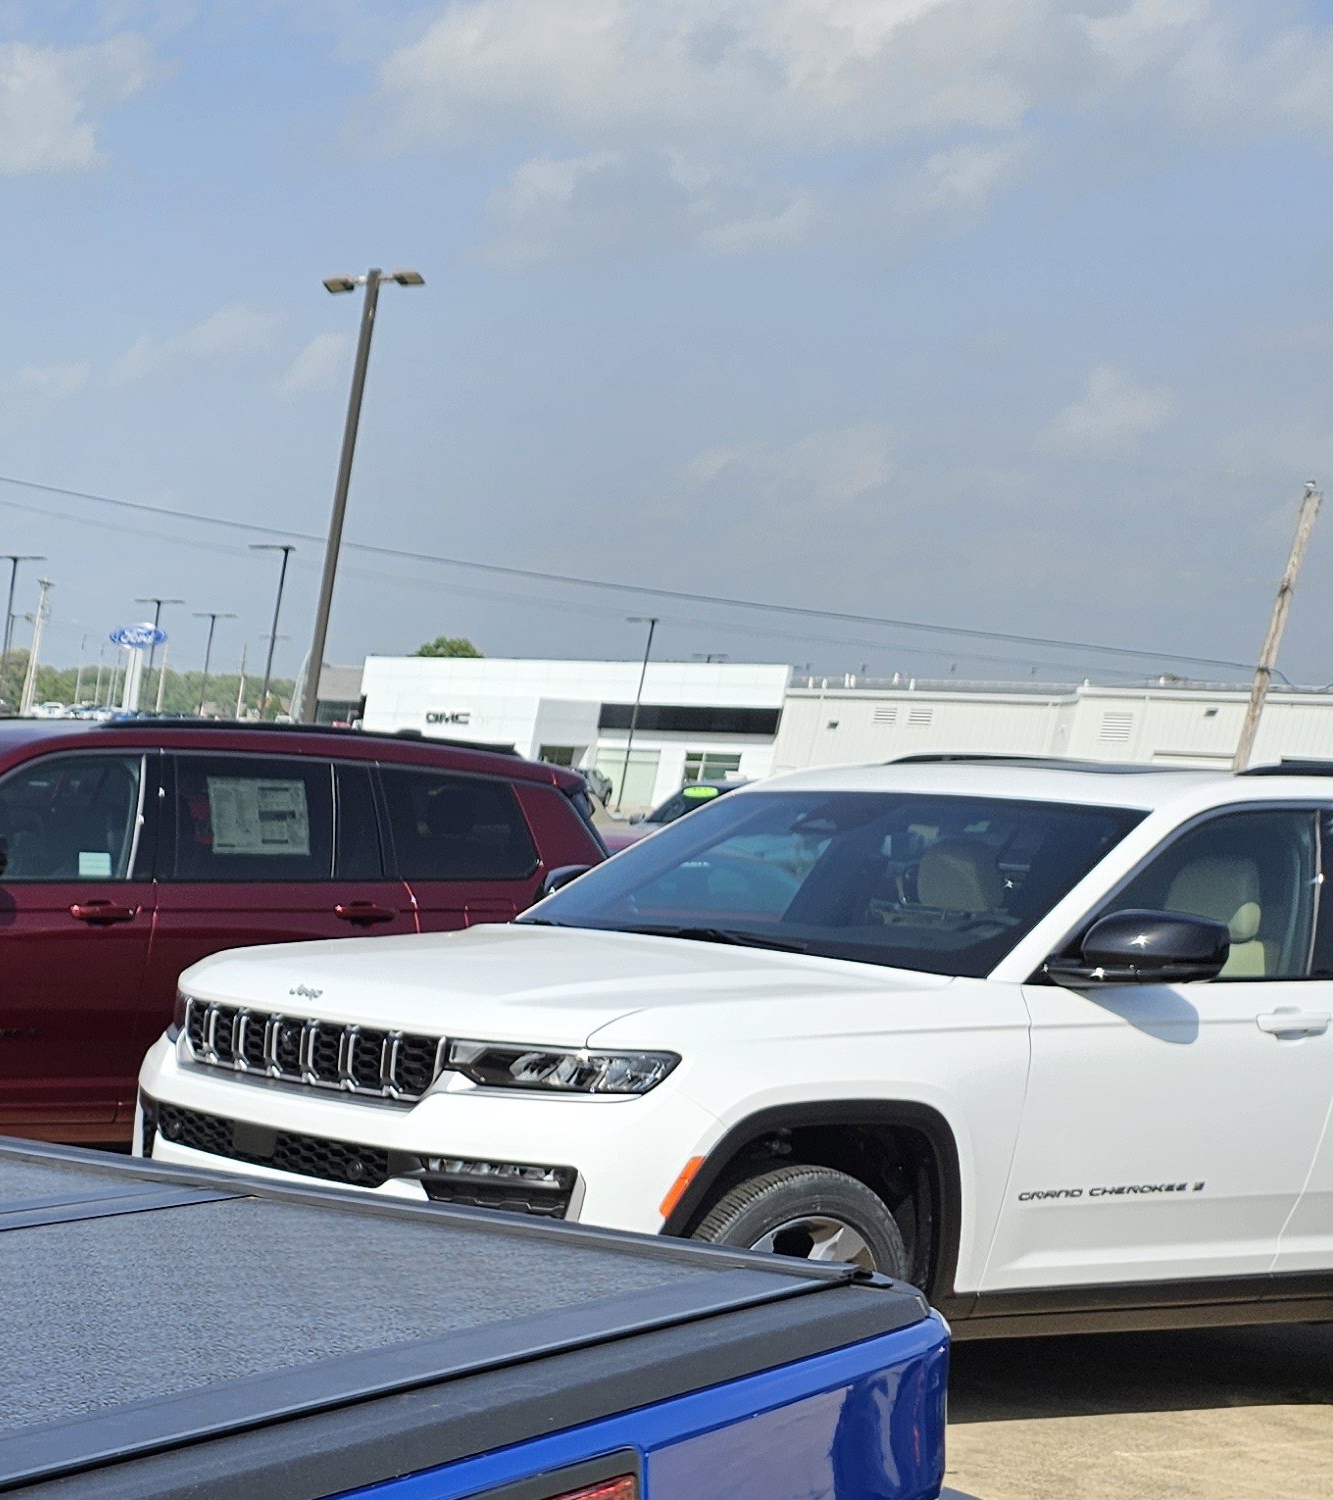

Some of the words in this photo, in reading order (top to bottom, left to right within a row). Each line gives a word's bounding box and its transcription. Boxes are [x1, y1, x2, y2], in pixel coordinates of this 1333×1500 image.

[425, 711, 471, 725] GMC
[1018, 1188, 1083, 1201] GRAND
[1089, 1181, 1189, 1197] CHEROKEE
